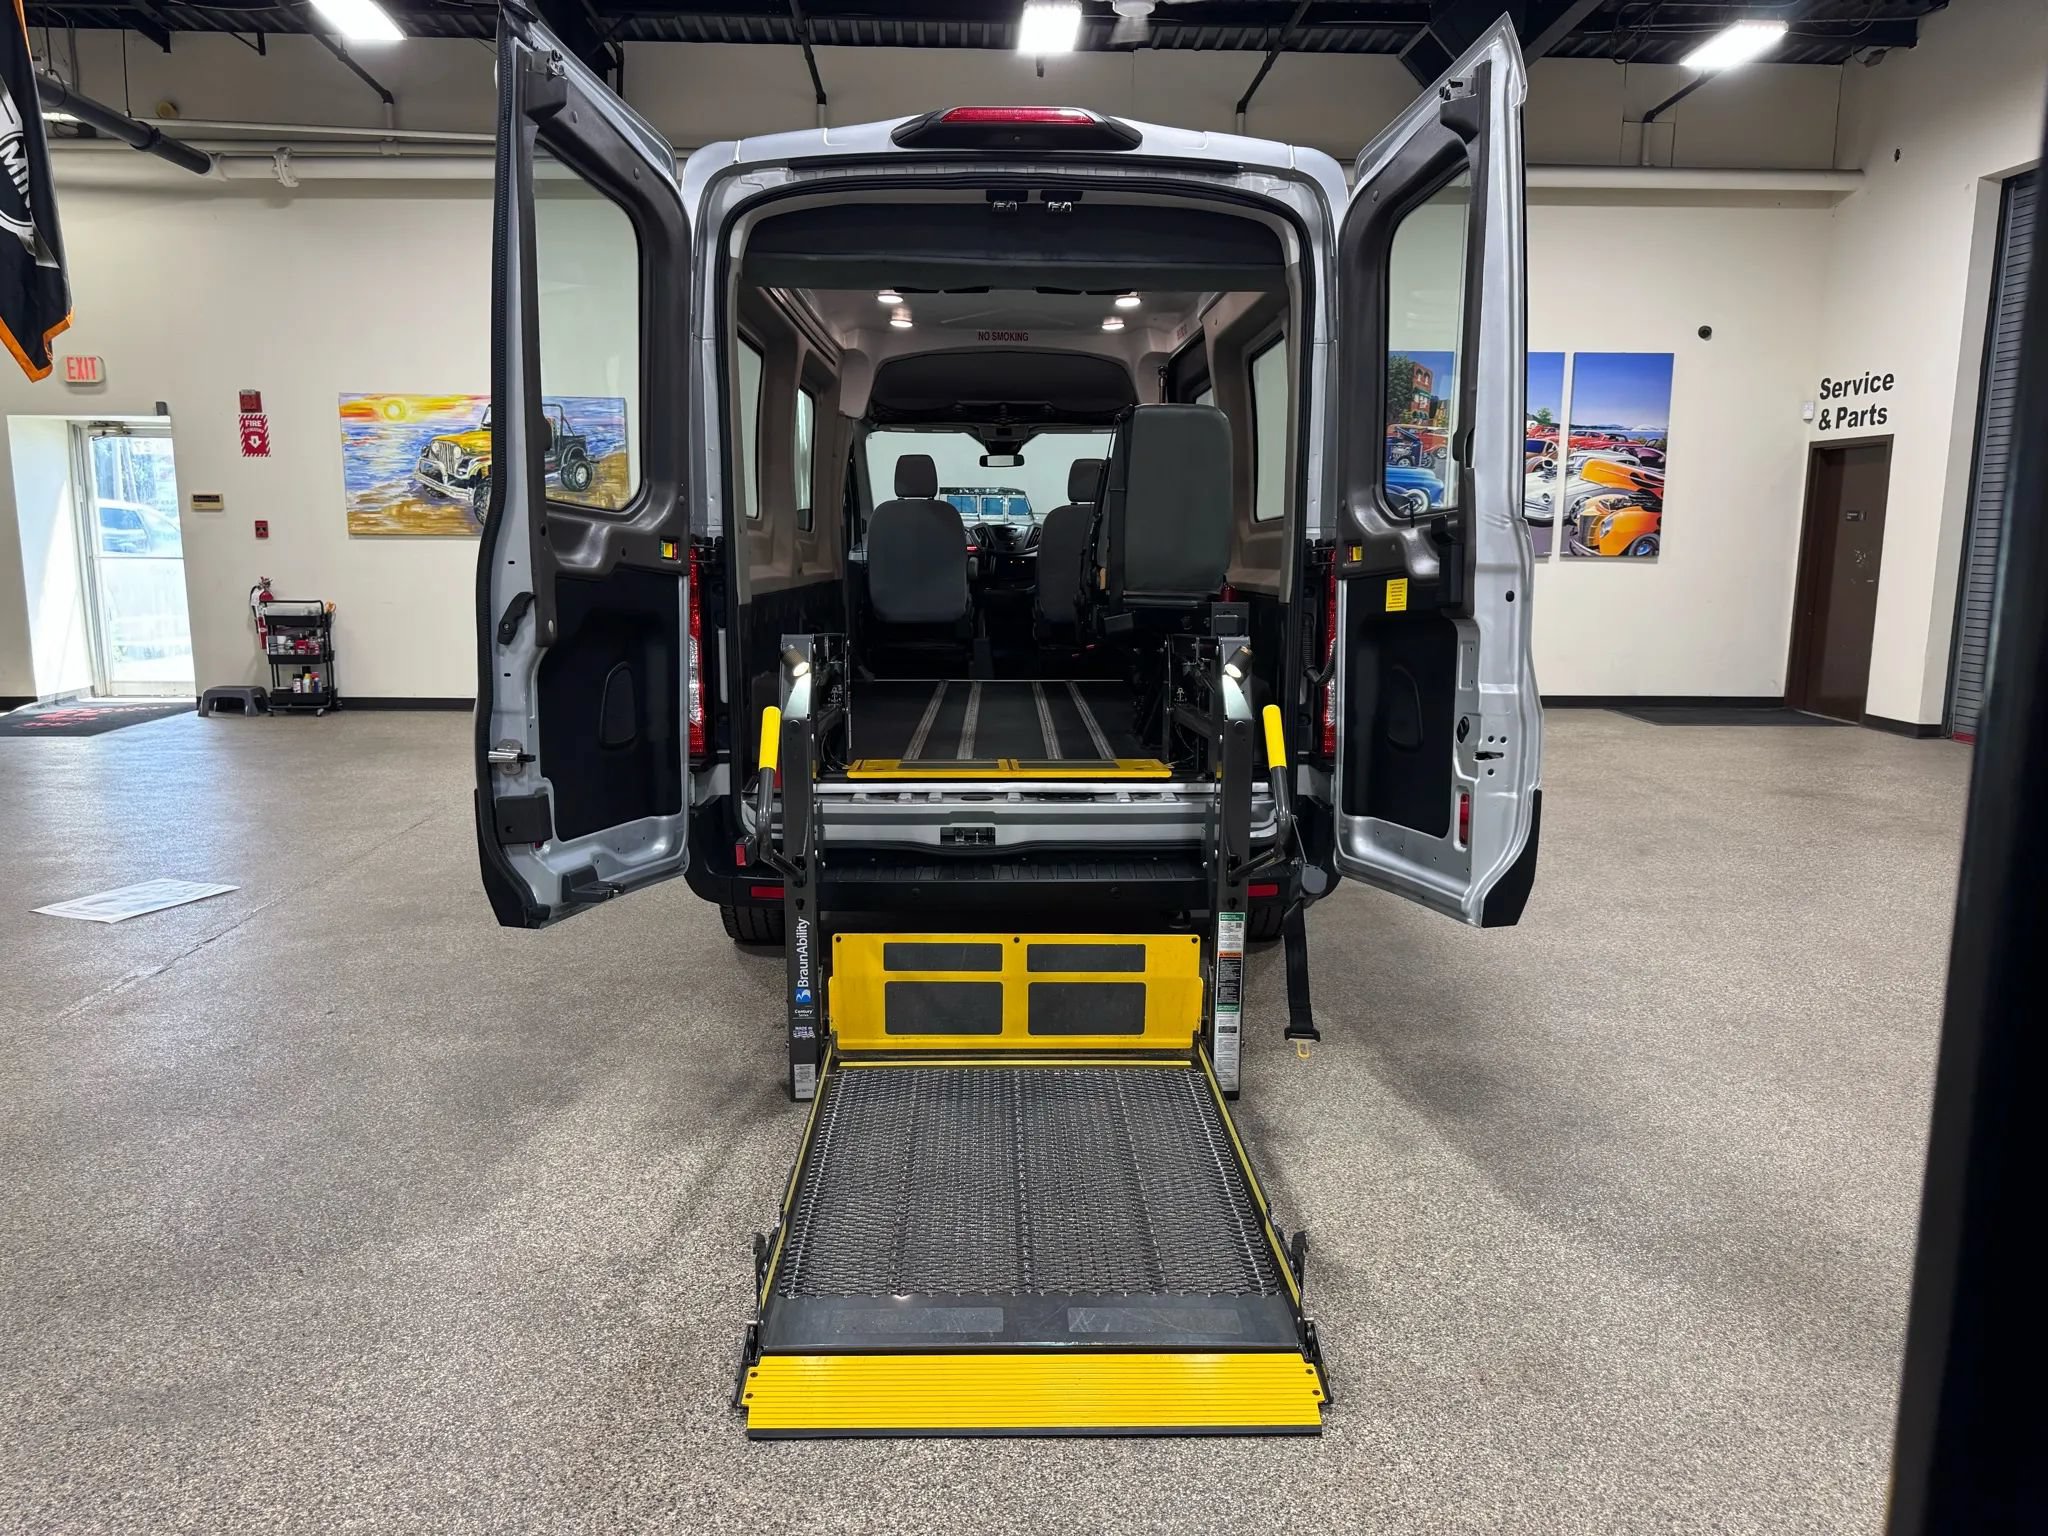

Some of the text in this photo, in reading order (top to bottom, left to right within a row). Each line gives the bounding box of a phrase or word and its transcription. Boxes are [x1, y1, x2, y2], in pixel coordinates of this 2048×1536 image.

[978, 331, 1029, 342] NO SMOKING
[66, 356, 97, 381] EXIT
[1820, 371, 1895, 400] Service
[1818, 403, 1888, 431] & Parts
[796, 916, 810, 987] BraunAbility
